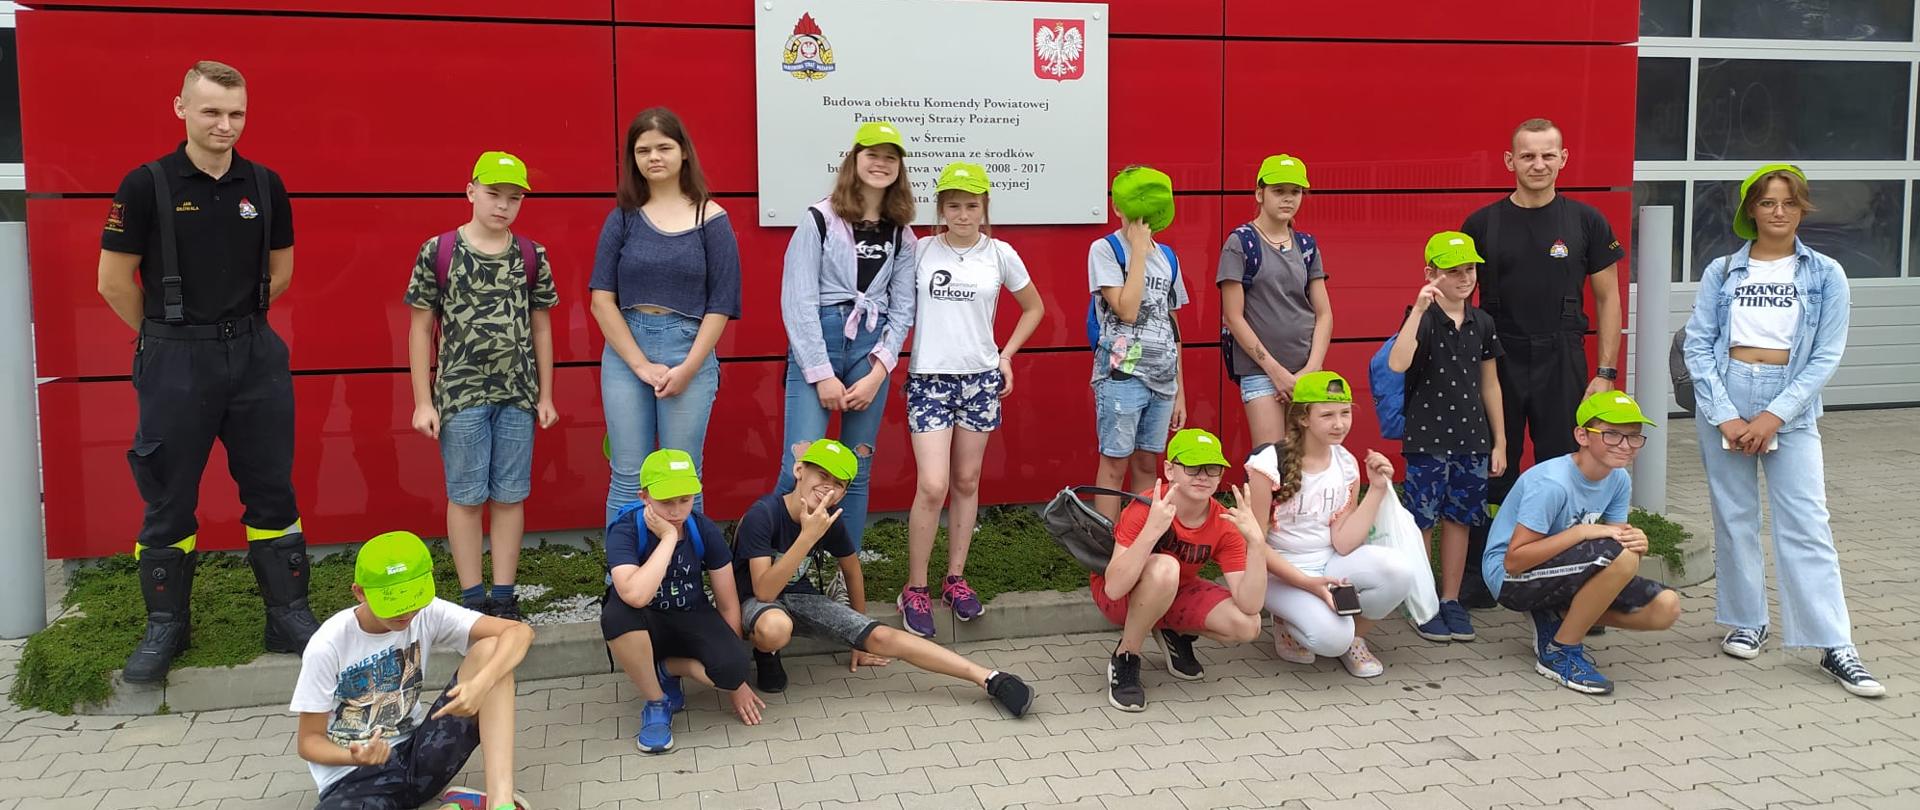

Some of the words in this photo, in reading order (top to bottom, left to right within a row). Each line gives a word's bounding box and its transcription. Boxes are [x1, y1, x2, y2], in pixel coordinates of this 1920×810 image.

[823, 96, 871, 107] Budowa
[875, 97, 920, 108] obiektu
[924, 97, 980, 110] Komendy
[984, 97, 1049, 111] Powiatowej
[854, 113, 925, 126] Państwowej
[928, 113, 966, 126] Straży
[969, 113, 1019, 127] Pożarnej
[924, 129, 967, 143] Śremie
[984, 148, 1035, 158] środków
[985, 163, 1011, 173] 2008
[1021, 163, 1046, 173] 2017
[929, 269, 977, 299] Parkour
[1738, 296, 1793, 307] THINGS
